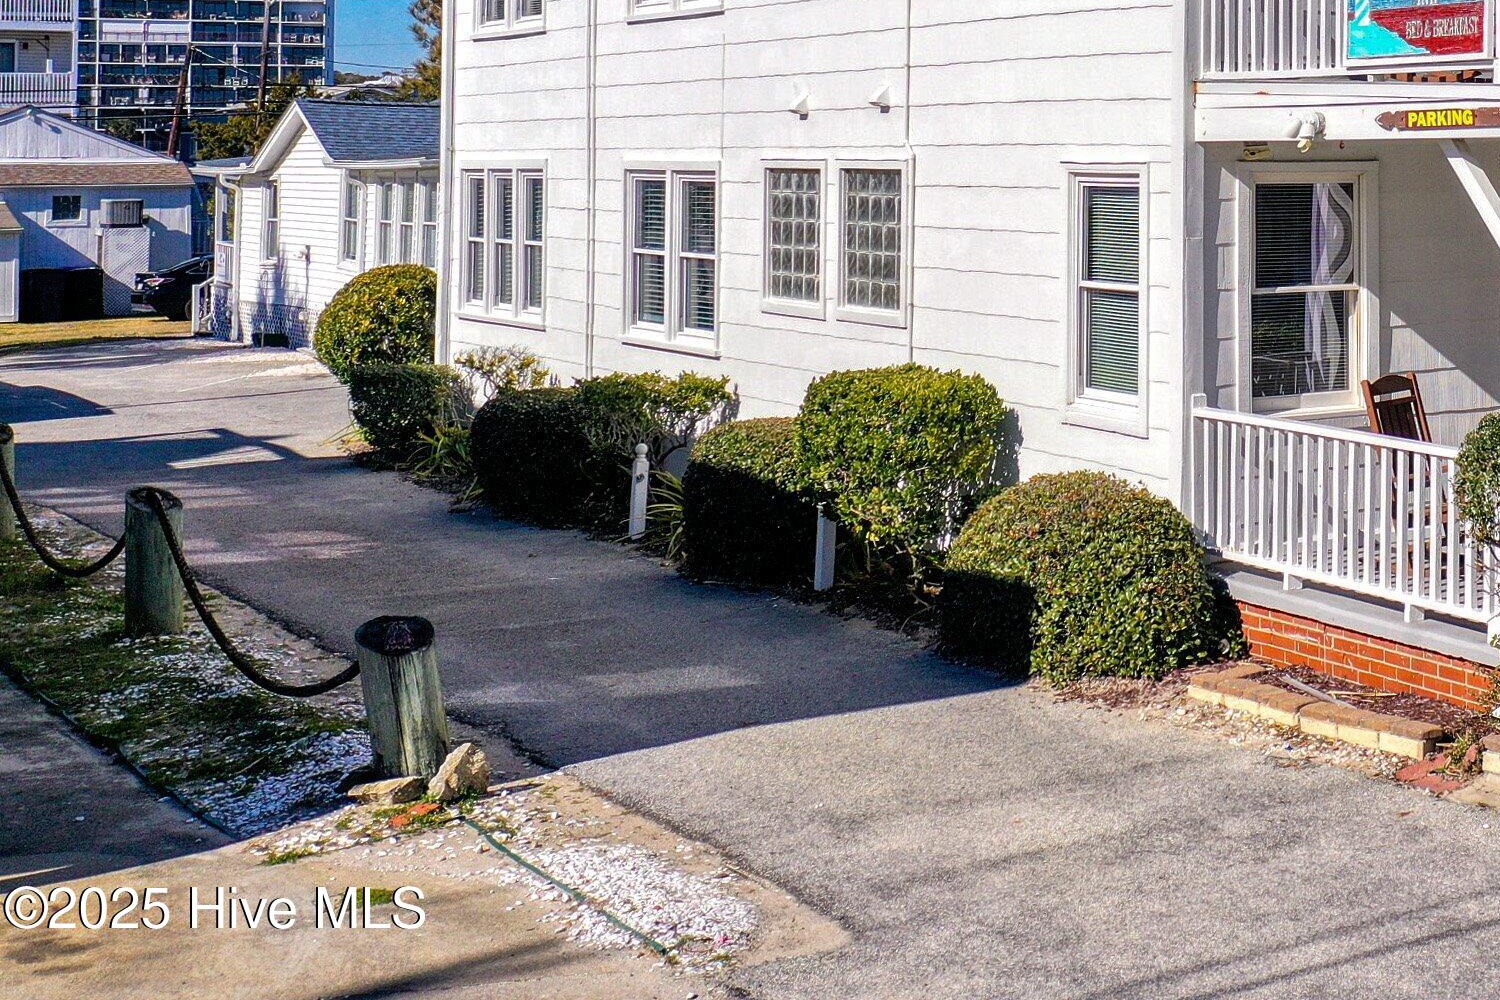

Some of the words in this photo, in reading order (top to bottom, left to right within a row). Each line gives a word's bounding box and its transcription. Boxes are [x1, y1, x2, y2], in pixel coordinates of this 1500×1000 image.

[1405, 20, 1423, 39] BED
[1424, 19, 1432, 38] &
[1433, 16, 1479, 37] BREAKFAST
[1407, 109, 1474, 127] PARKING
